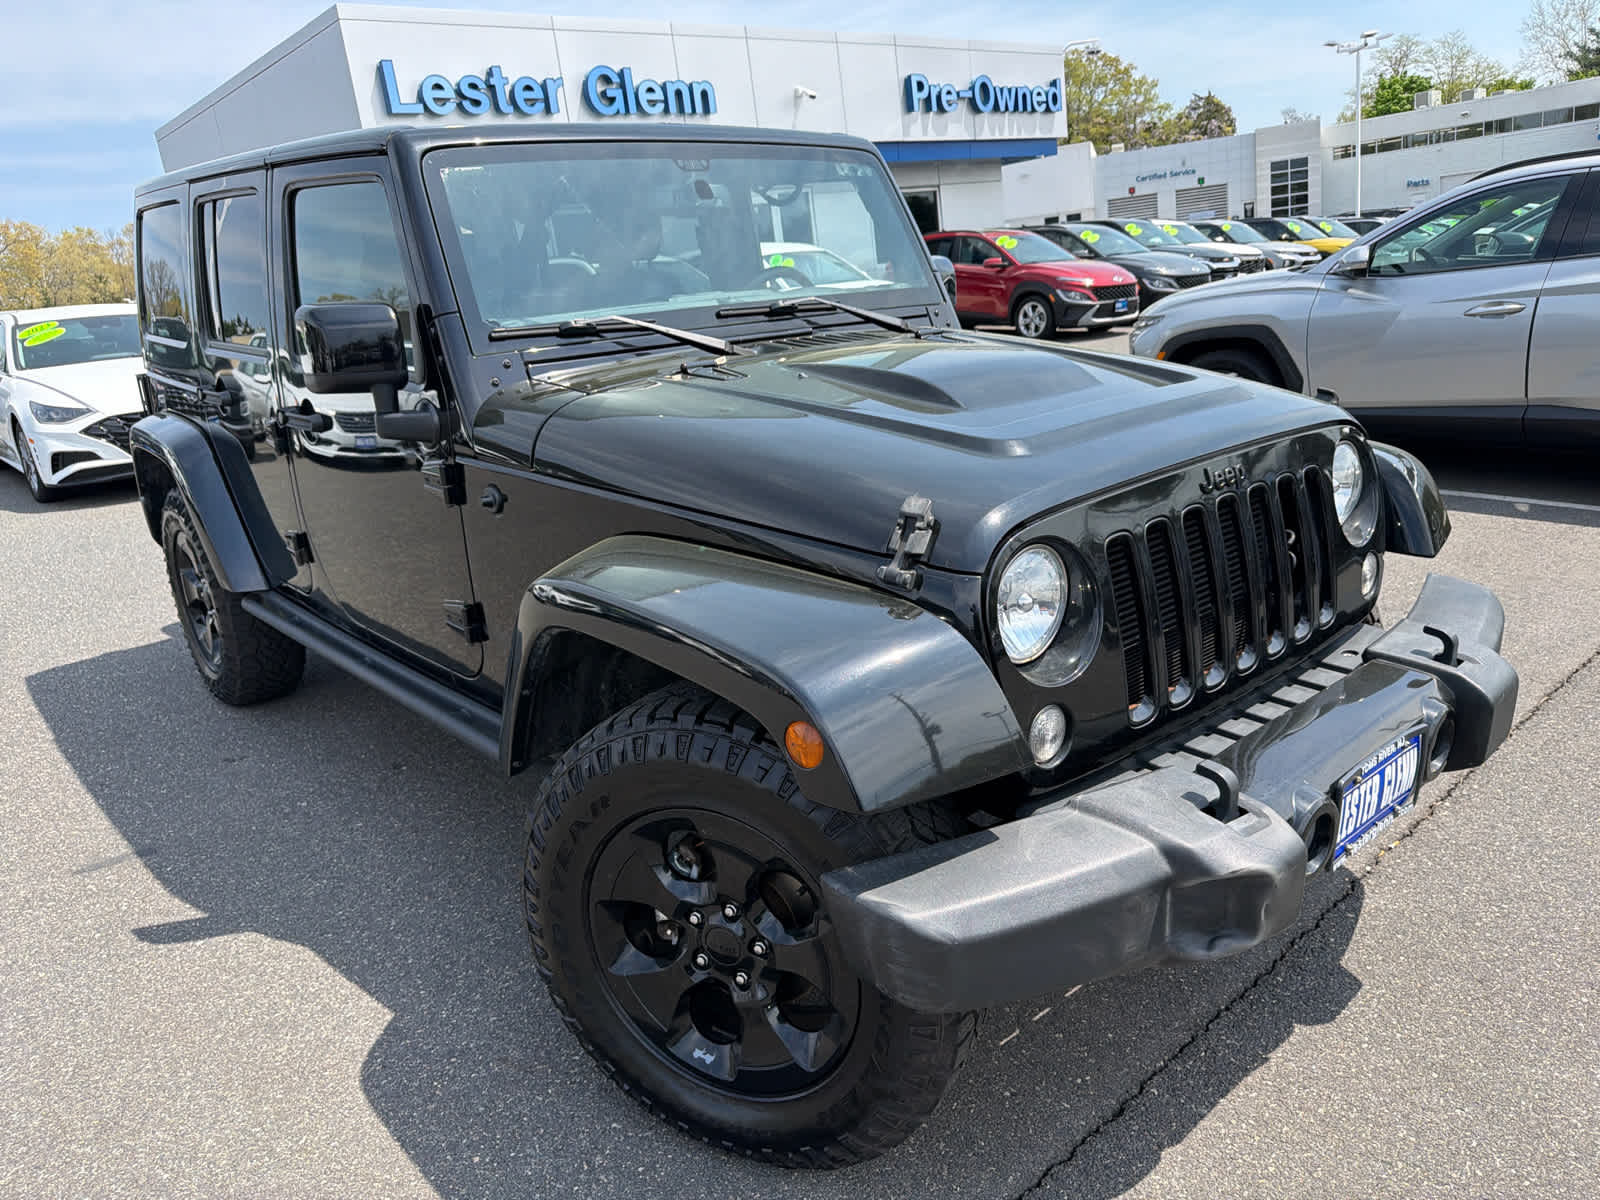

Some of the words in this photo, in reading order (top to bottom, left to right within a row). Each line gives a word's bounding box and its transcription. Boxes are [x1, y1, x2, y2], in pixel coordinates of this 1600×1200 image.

[377, 59, 563, 115] Lester
[584, 65, 717, 115] Glenn
[905, 73, 1062, 113] Pre-Owned
[1136, 172, 1167, 182] Certified
[1169, 168, 1196, 177] Service
[1407, 179, 1430, 188] Parts
[1199, 464, 1245, 494] Jeep
